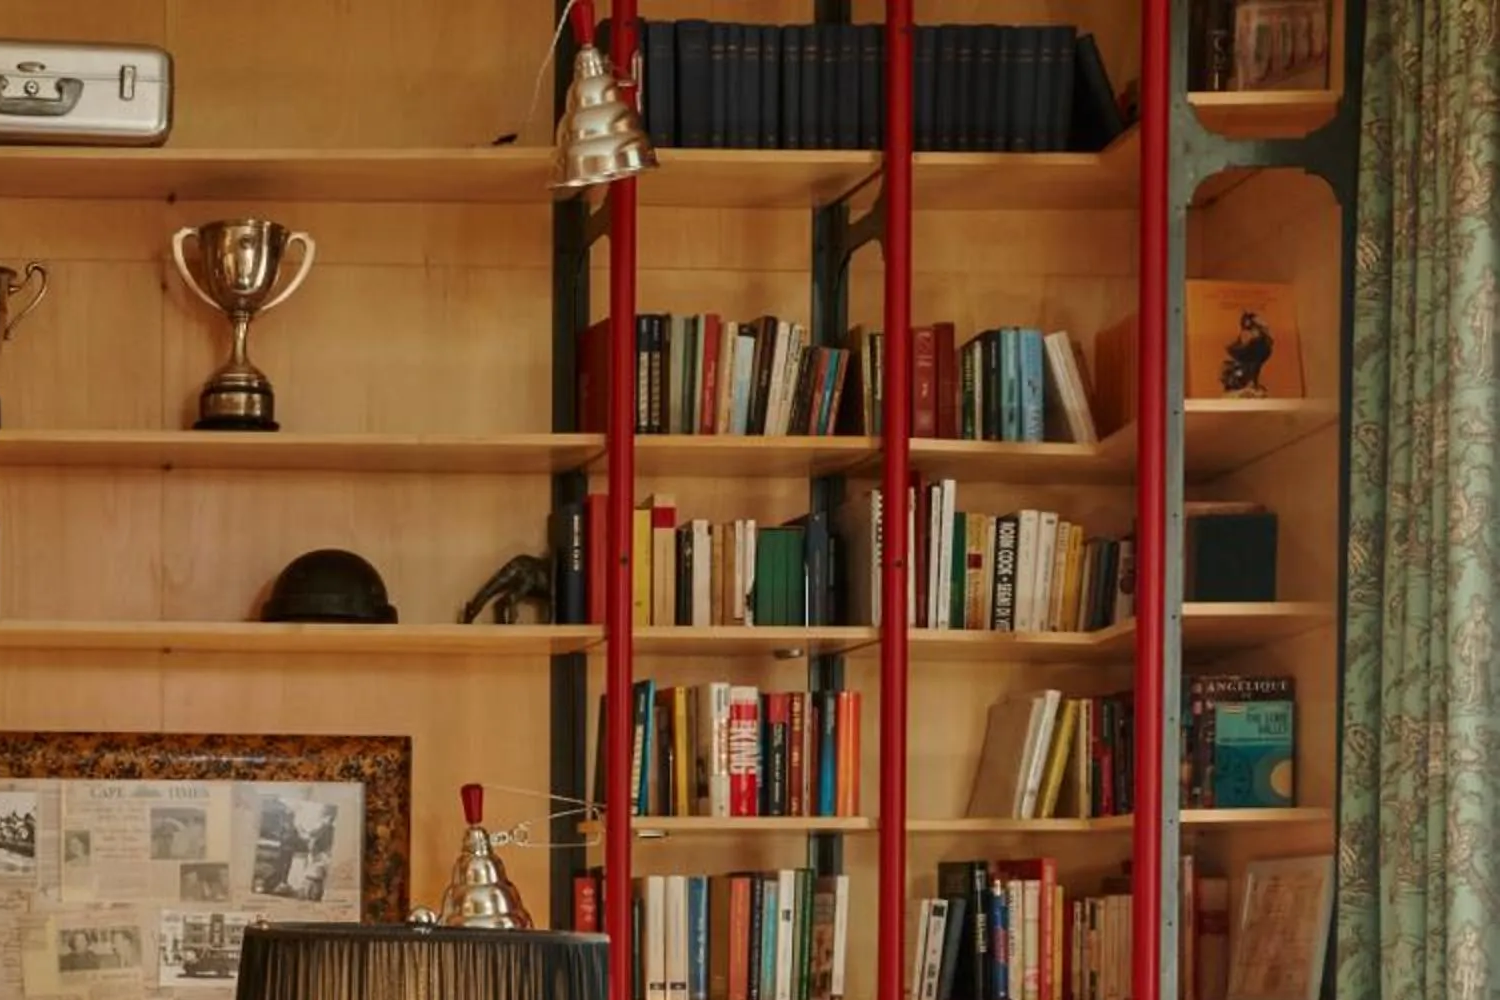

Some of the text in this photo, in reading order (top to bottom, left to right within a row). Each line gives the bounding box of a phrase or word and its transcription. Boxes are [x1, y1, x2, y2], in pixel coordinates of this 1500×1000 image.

[998, 521, 1015, 549] ROBIN
[998, 549, 1013, 575] COOK
[1206, 679, 1288, 693] ANGELIQUE
[729, 727, 757, 775] KING
[89, 786, 125, 799] CAPE
